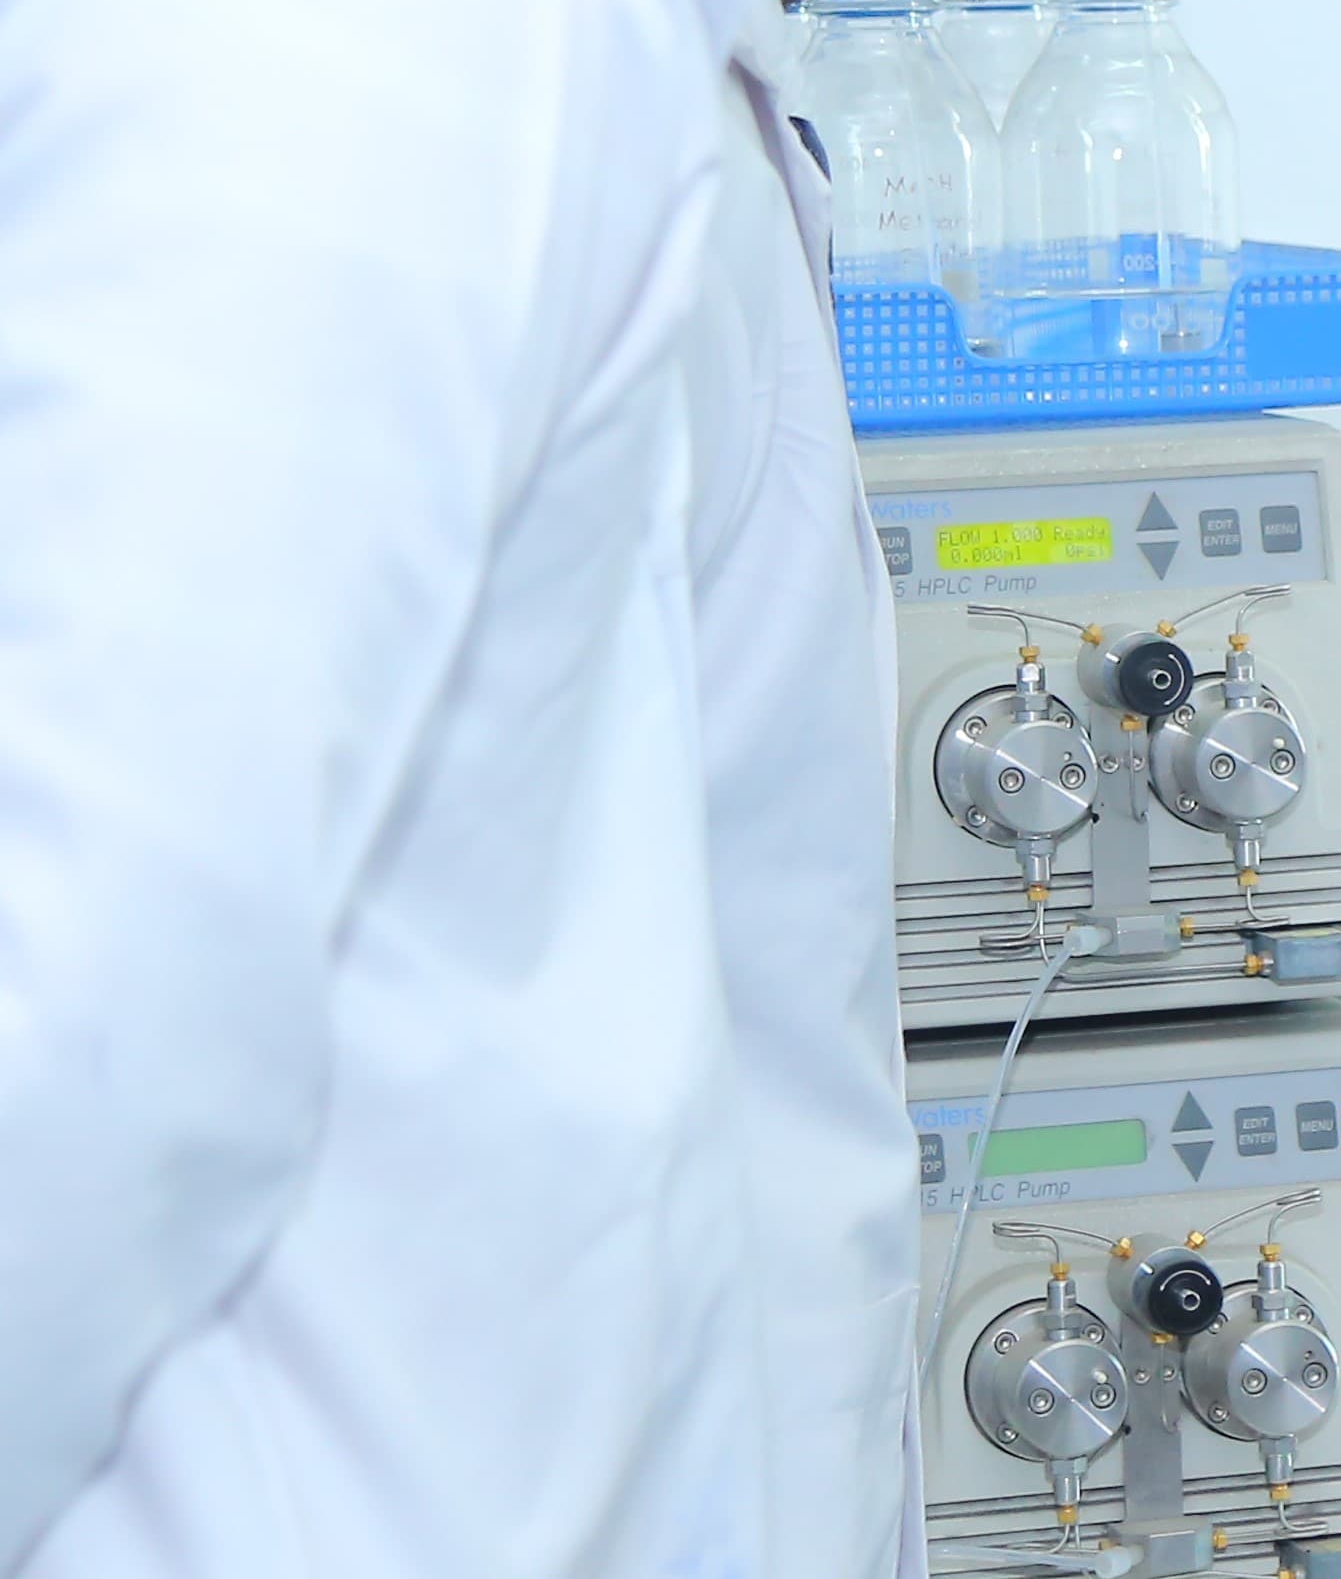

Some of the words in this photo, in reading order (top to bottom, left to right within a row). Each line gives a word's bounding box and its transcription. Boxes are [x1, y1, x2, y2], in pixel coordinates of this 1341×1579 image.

[1207, 518, 1234, 531] EDIT
[1264, 523, 1299, 536] MENU
[938, 529, 981, 547] FLOW
[993, 526, 1043, 544] 1.000
[1203, 533, 1241, 547] ENTER
[886, 553, 910, 565] TOP
[917, 575, 972, 597] HPLC
[984, 574, 1038, 595] Pump
[1242, 1117, 1270, 1130] EDIT
[1301, 1119, 1335, 1133] MENU
[1238, 1132, 1276, 1145] ENTER
[1017, 1180, 1071, 1199] Pump
